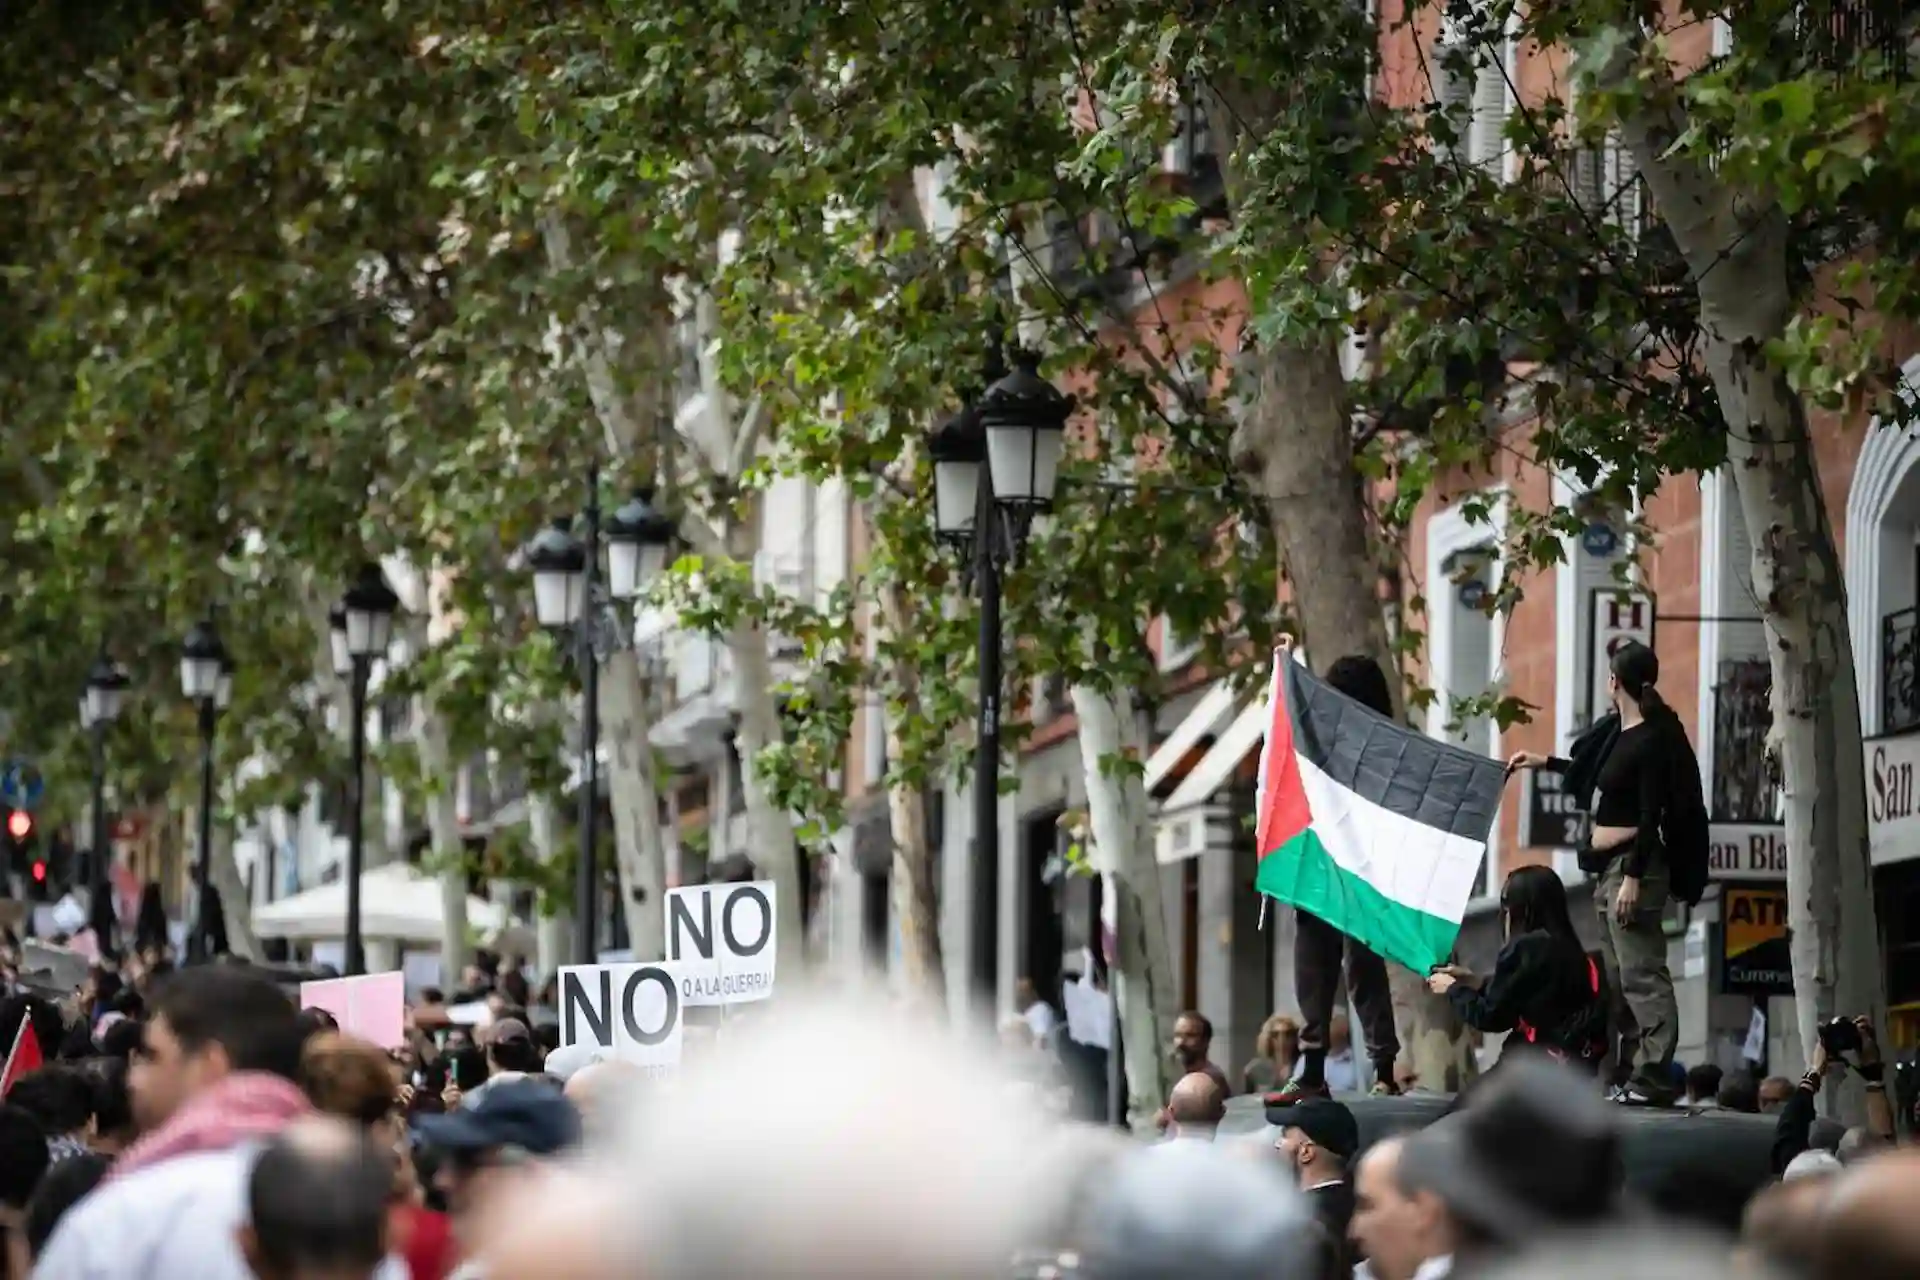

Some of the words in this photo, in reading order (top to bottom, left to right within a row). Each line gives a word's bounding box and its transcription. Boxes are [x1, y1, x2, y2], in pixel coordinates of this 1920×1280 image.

[1872, 745, 1913, 824] San
[1747, 832, 1787, 871] Bla
[669, 886, 772, 961] NO
[563, 966, 678, 1047] NO
[695, 977, 703, 996] A
[705, 975, 721, 996] LA
